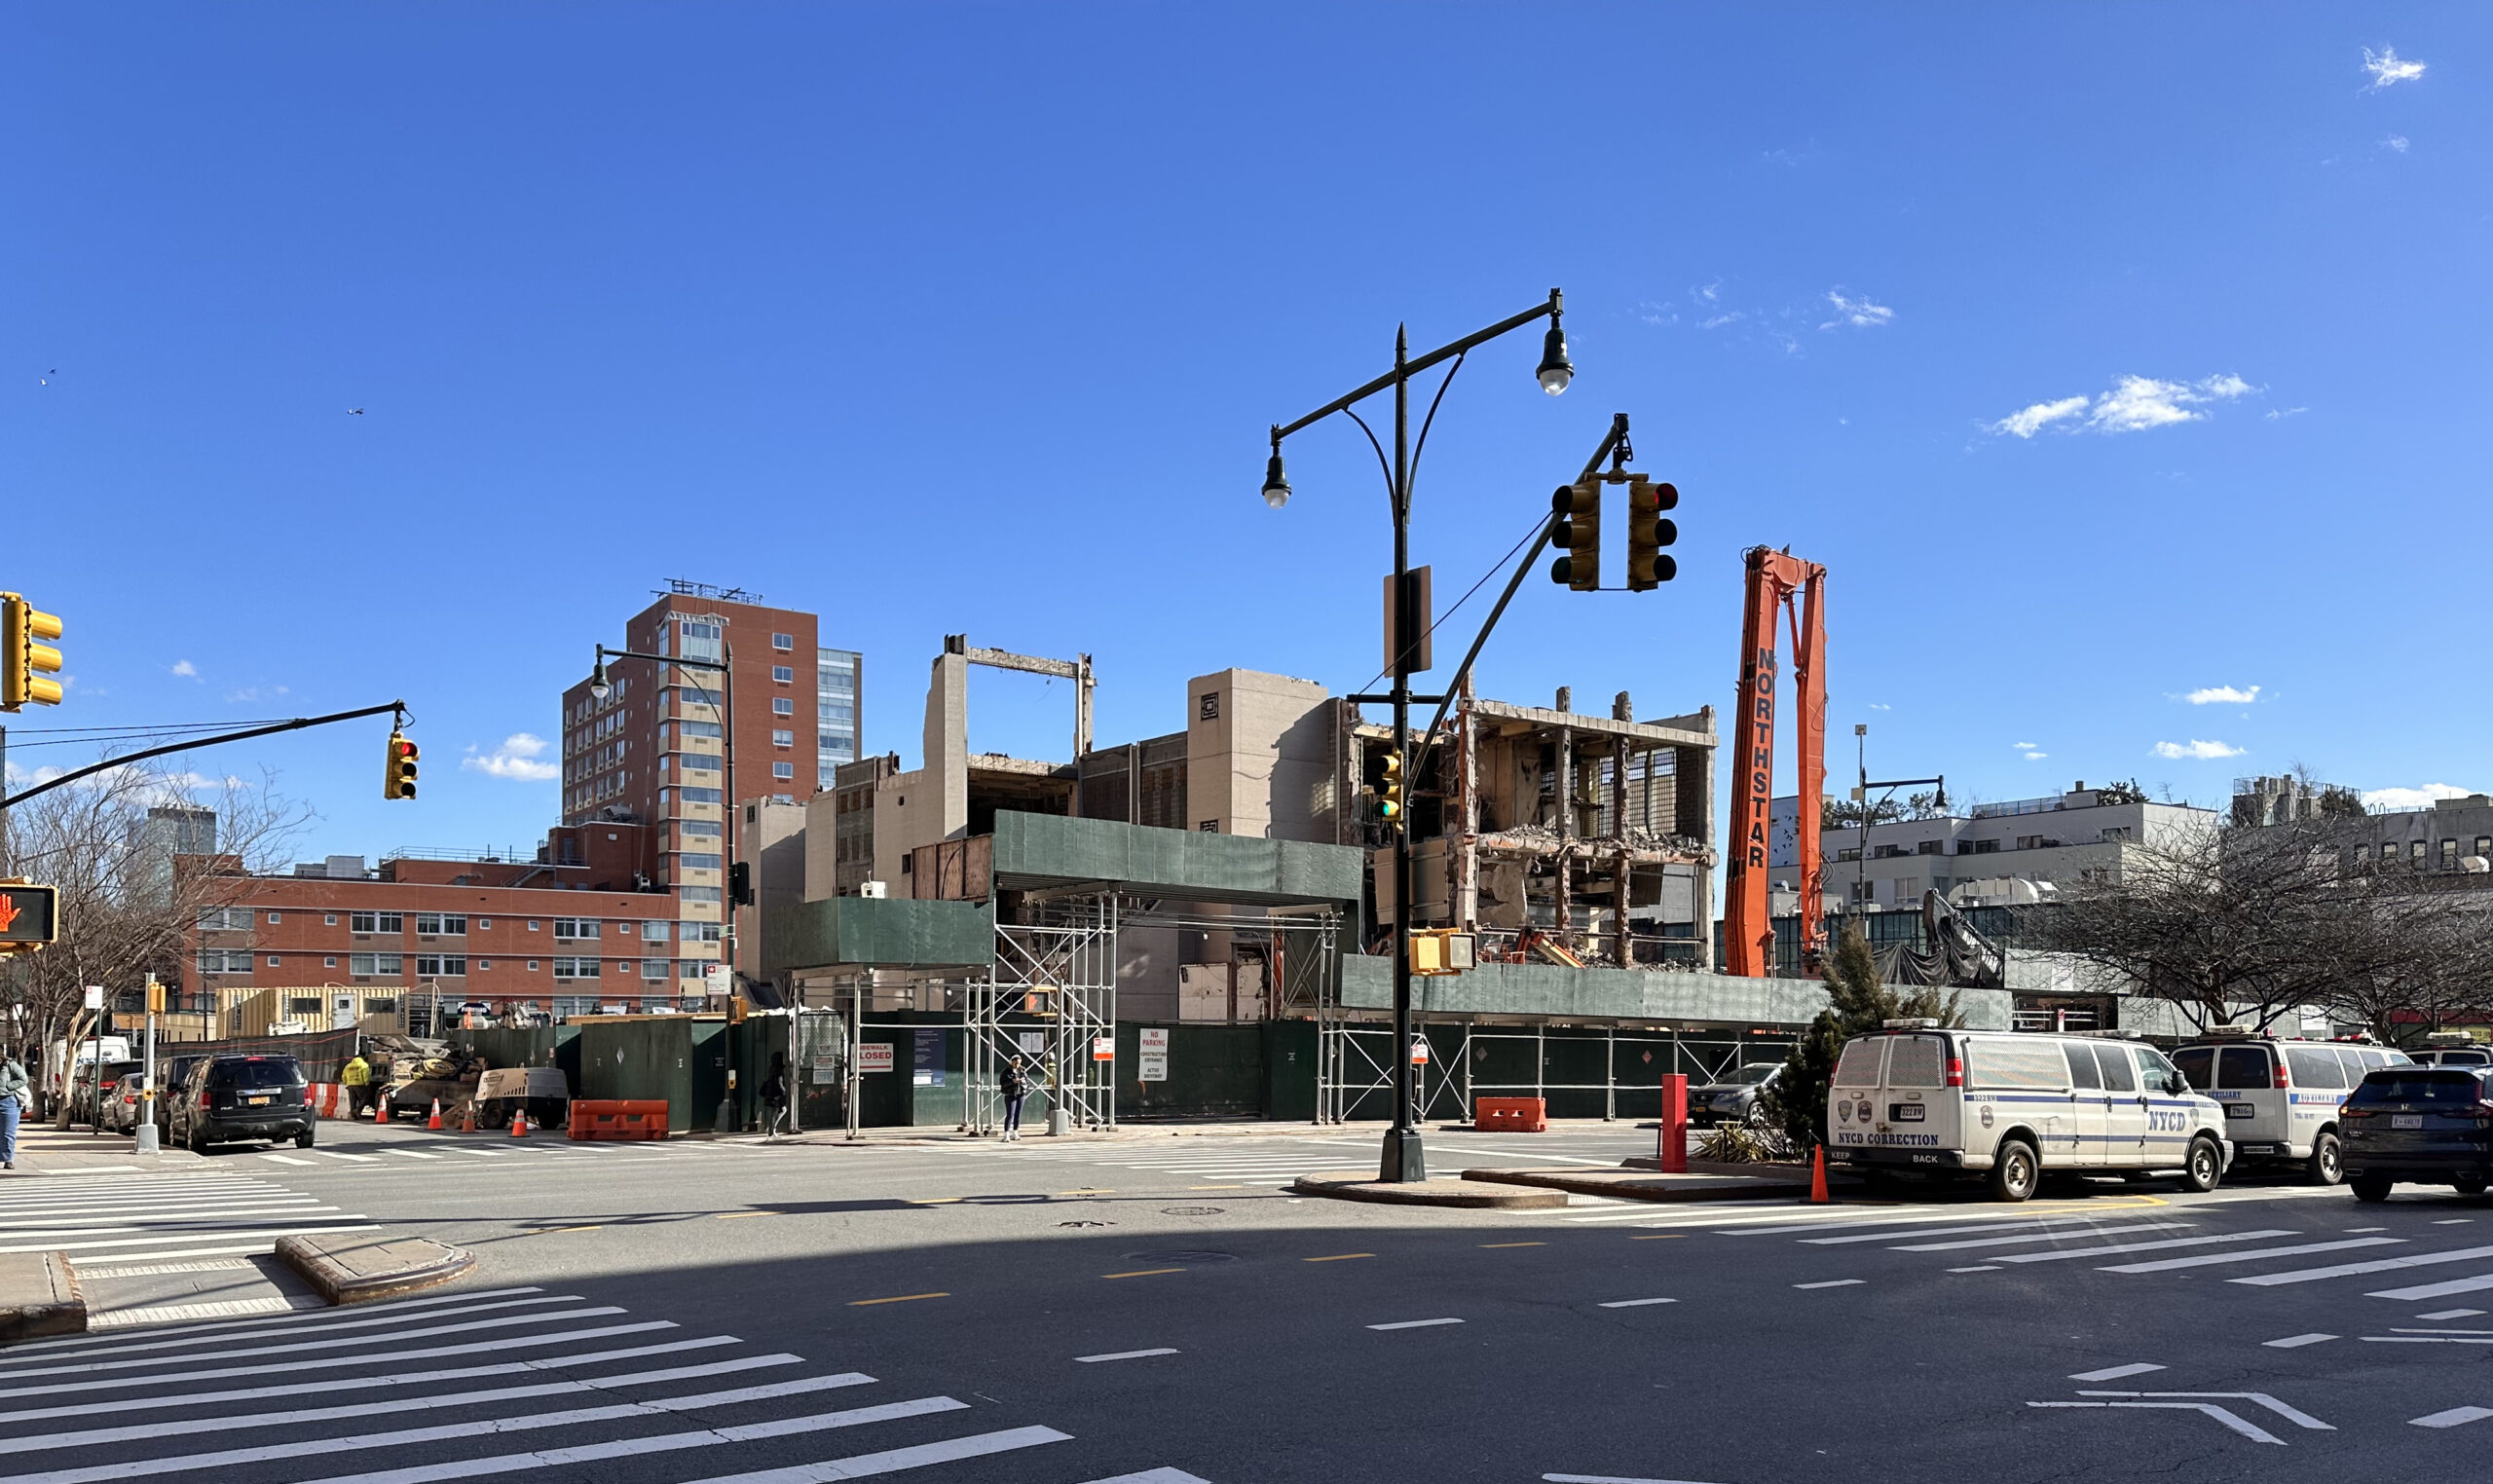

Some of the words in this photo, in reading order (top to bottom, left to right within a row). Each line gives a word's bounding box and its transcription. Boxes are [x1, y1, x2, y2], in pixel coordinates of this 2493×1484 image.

[1749, 647, 1774, 869] NORTHSTAR
[2296, 1094, 2338, 1103] AUXILIARY
[2148, 1110, 2186, 1132] NYCD
[1839, 1132, 1863, 1144] NYCD
[1868, 1133, 1939, 1146] CORRECTION
[1831, 1151, 1850, 1160] KEEP
[1913, 1155, 1939, 1164] BACK
